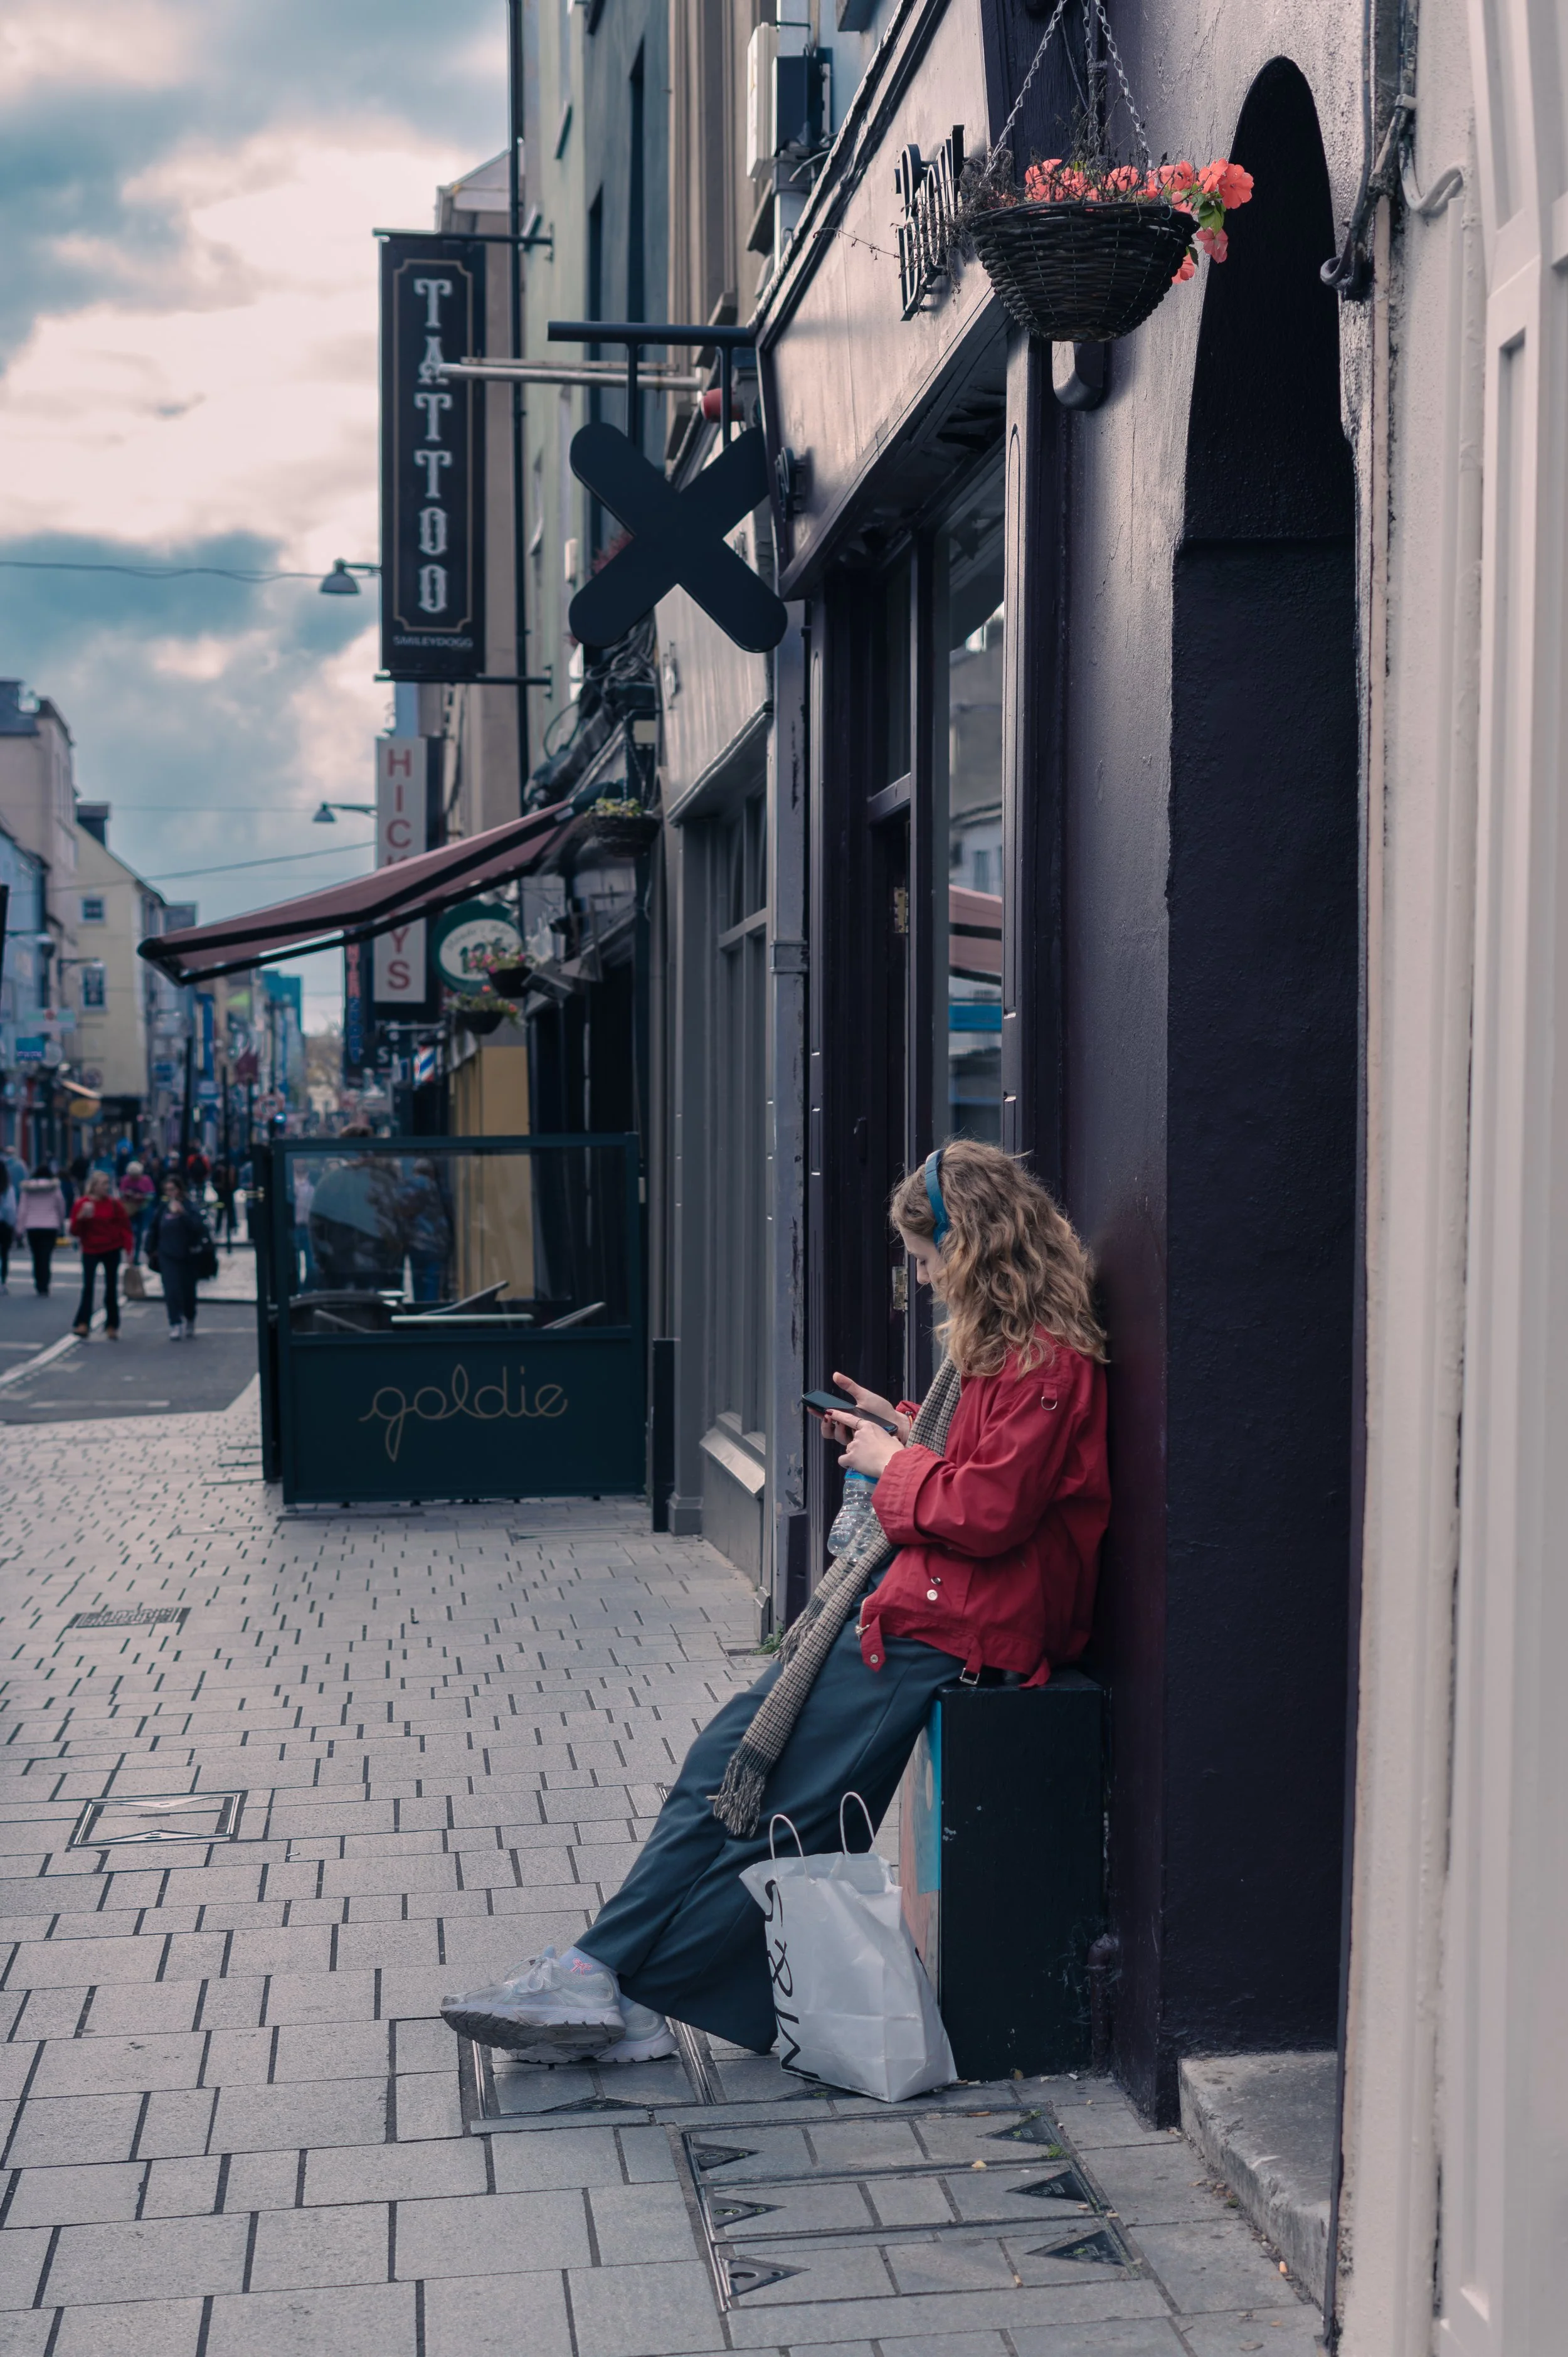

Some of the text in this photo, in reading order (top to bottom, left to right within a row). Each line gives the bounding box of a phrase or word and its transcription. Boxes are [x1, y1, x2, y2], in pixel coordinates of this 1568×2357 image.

[413, 277, 453, 614] TATTOO
[386, 748, 412, 990] HICYS
[358, 1363, 568, 1462] goldie
